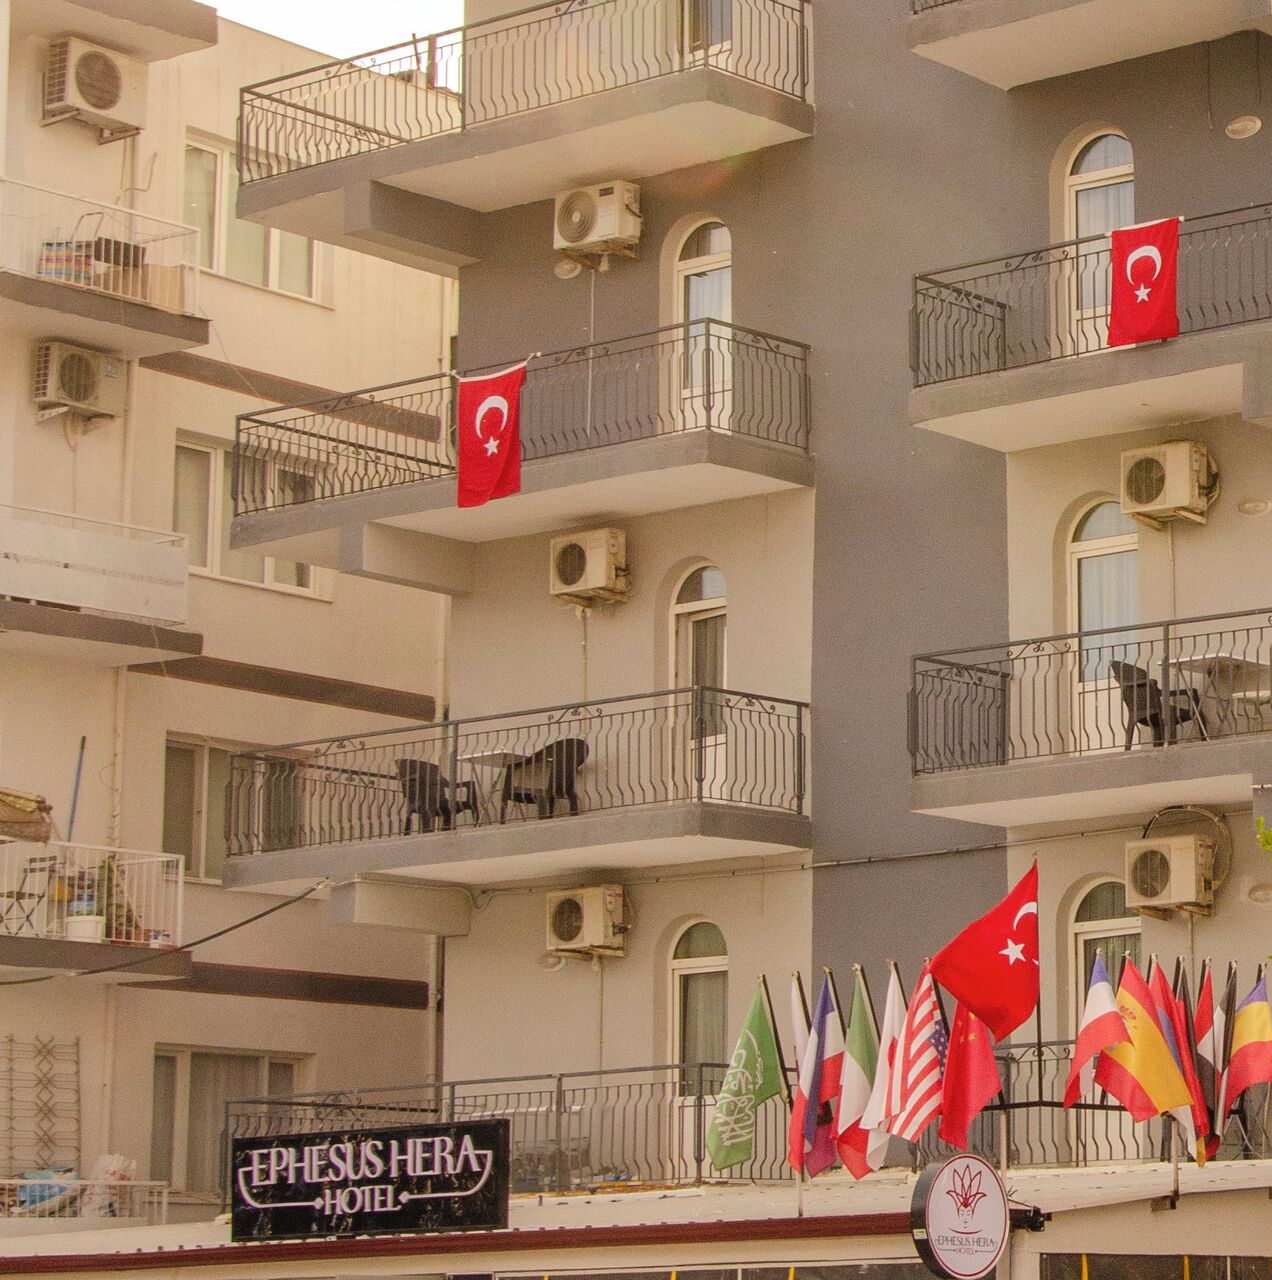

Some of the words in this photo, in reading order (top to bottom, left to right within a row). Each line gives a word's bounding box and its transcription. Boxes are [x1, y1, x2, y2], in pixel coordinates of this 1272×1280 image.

[251, 1140, 384, 1186] EPHESUS
[390, 1134, 481, 1178] HERA
[324, 1185, 402, 1214] HOTEL
[937, 1235, 971, 1246] EPHESUS
[973, 1238, 995, 1247] HERA
[955, 1247, 975, 1255] HOTEL
